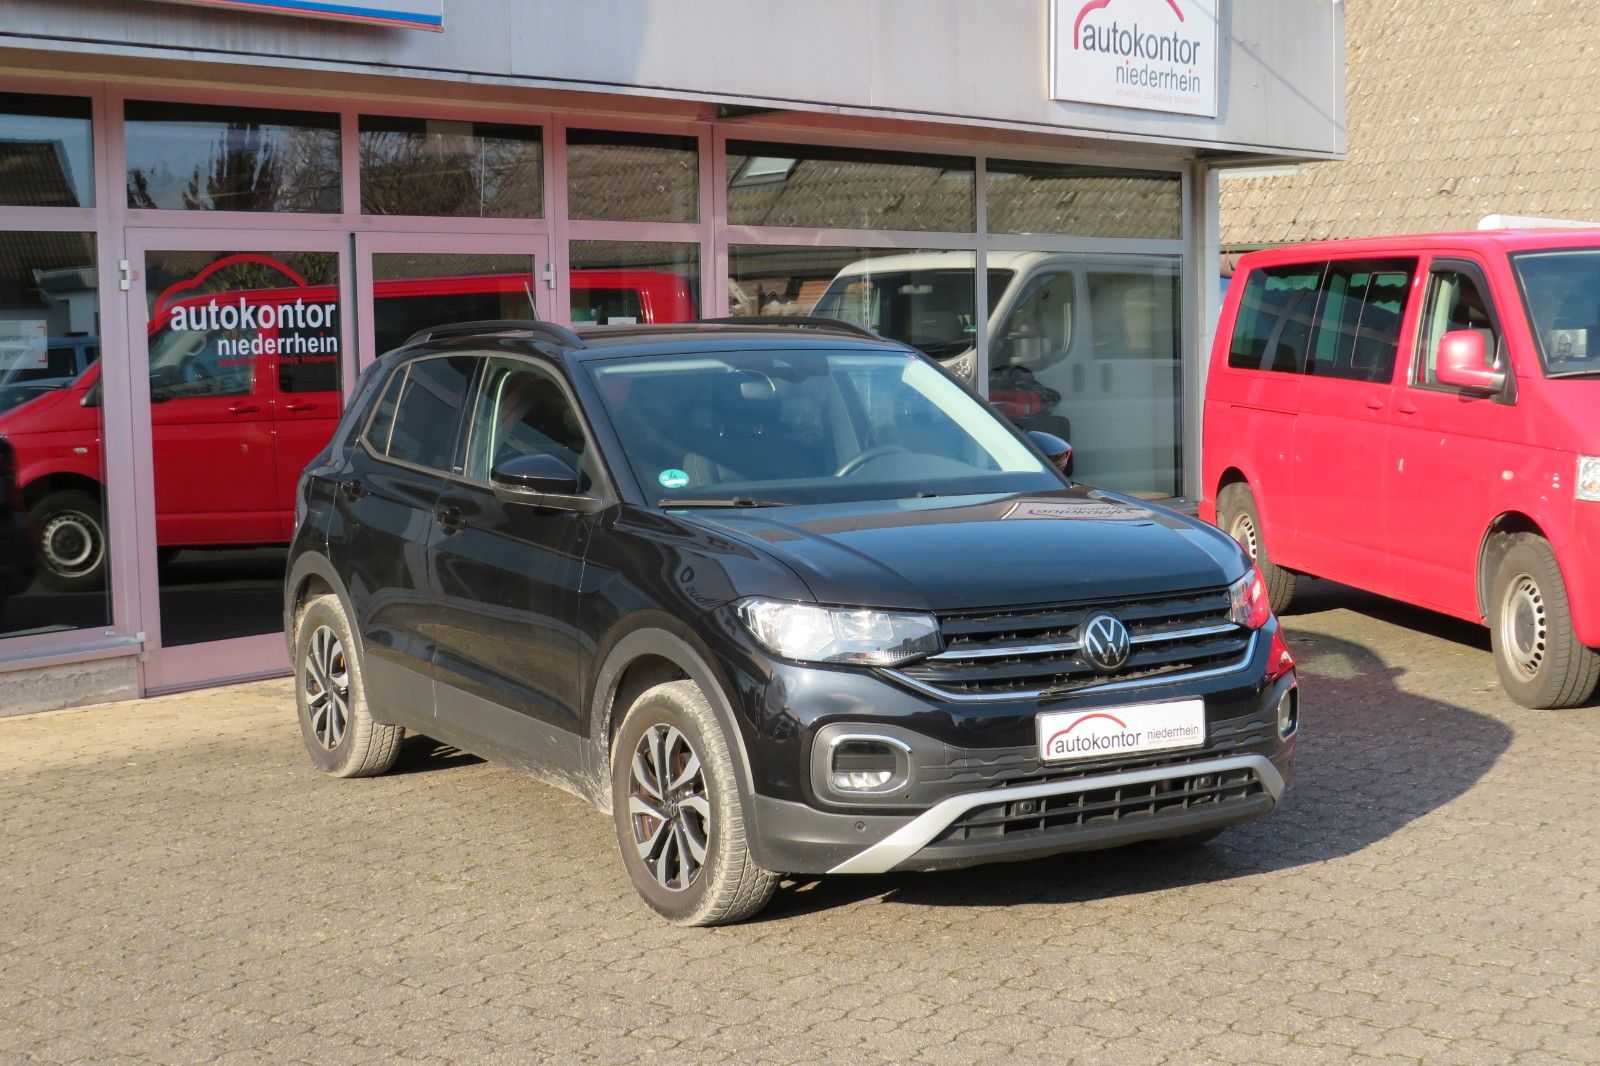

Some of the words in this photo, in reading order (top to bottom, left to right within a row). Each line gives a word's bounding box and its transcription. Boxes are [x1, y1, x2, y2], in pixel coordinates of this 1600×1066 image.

[1082, 21, 1200, 65] autokontor
[1115, 60, 1200, 93] niederrhein
[170, 297, 336, 331] autokontor
[217, 332, 338, 356] niederrhein
[1055, 731, 1142, 754] autokontor
[1147, 724, 1199, 740] niederrhein
